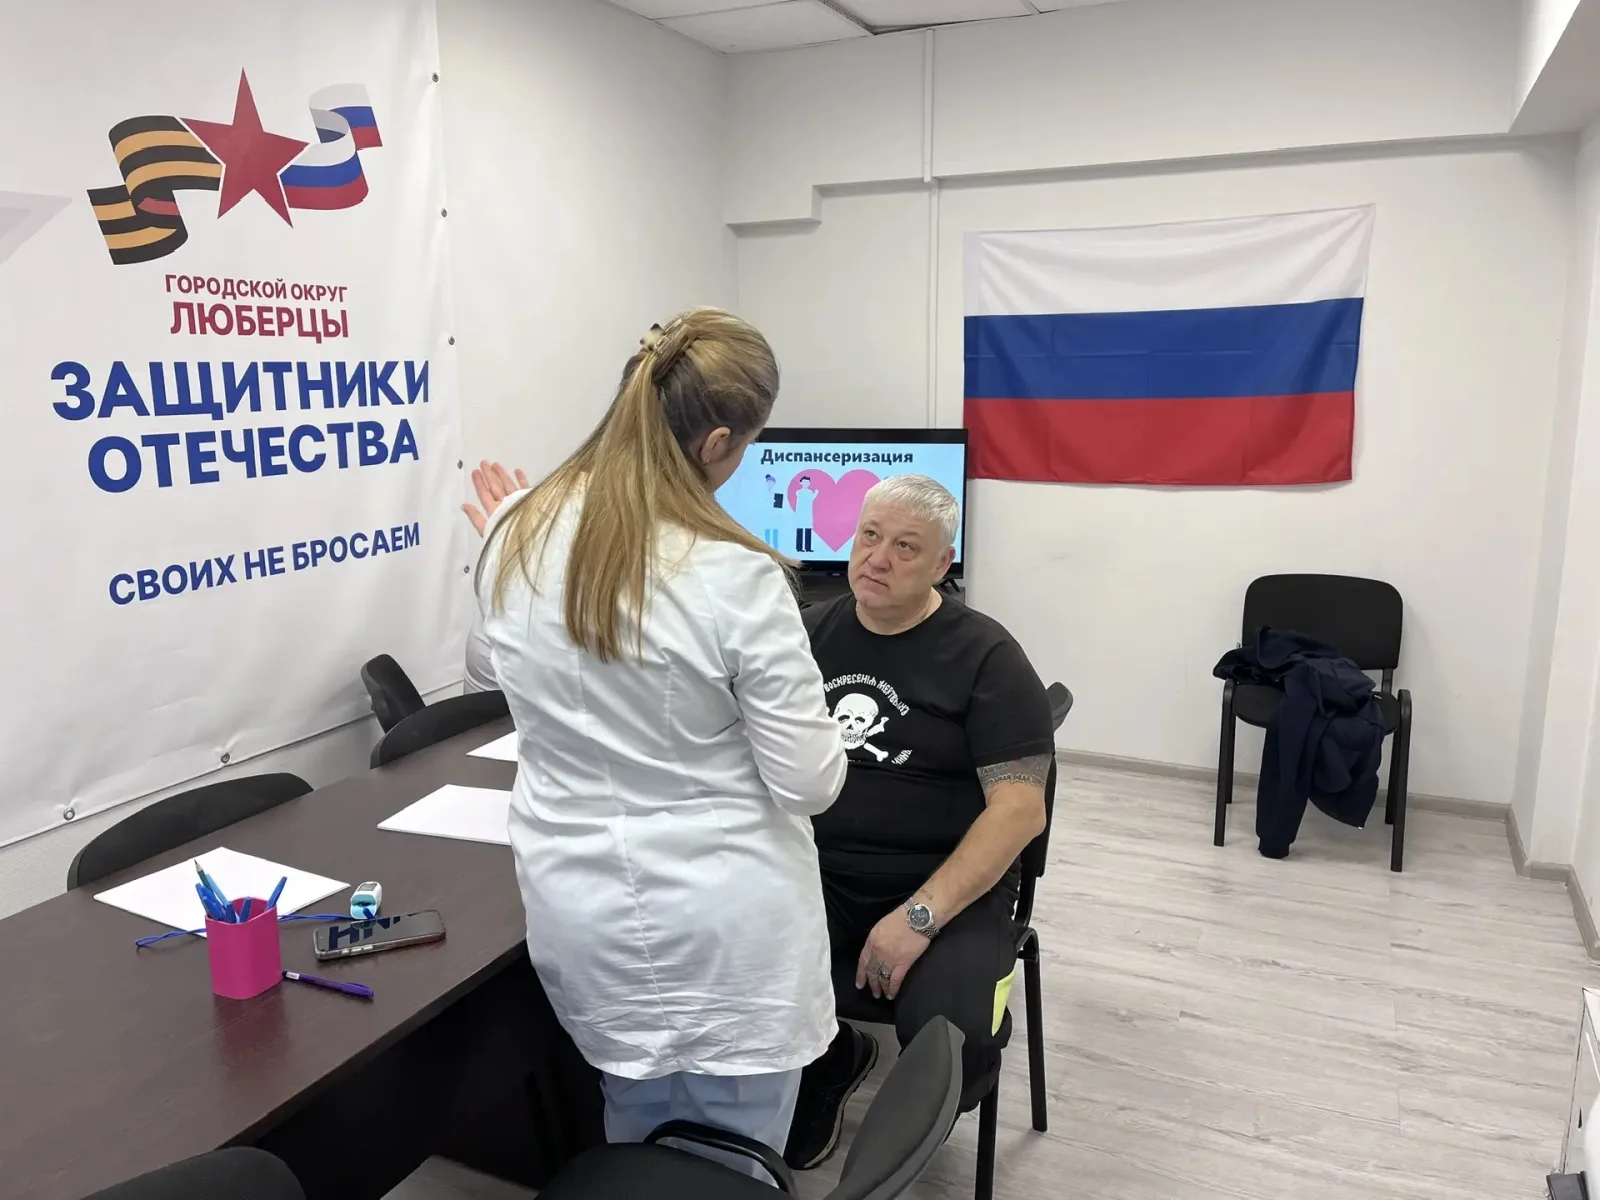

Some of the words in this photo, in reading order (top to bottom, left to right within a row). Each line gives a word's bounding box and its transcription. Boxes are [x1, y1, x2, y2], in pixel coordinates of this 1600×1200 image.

[165, 274, 287, 300] ГОРОДСКОЙ
[291, 283, 348, 302] ОКРУГ
[170, 301, 349, 344] ЛЮБЕРЦЫ
[50, 360, 430, 421] ЗАЩИТНИКИ
[88, 418, 419, 493] ОТЕЧЕСТВА
[760, 449, 914, 466] Диспансеризация
[108, 554, 237, 605] СВОИХ
[244, 546, 286, 579] НЕ
[292, 522, 420, 571] БРОСАЕМ
